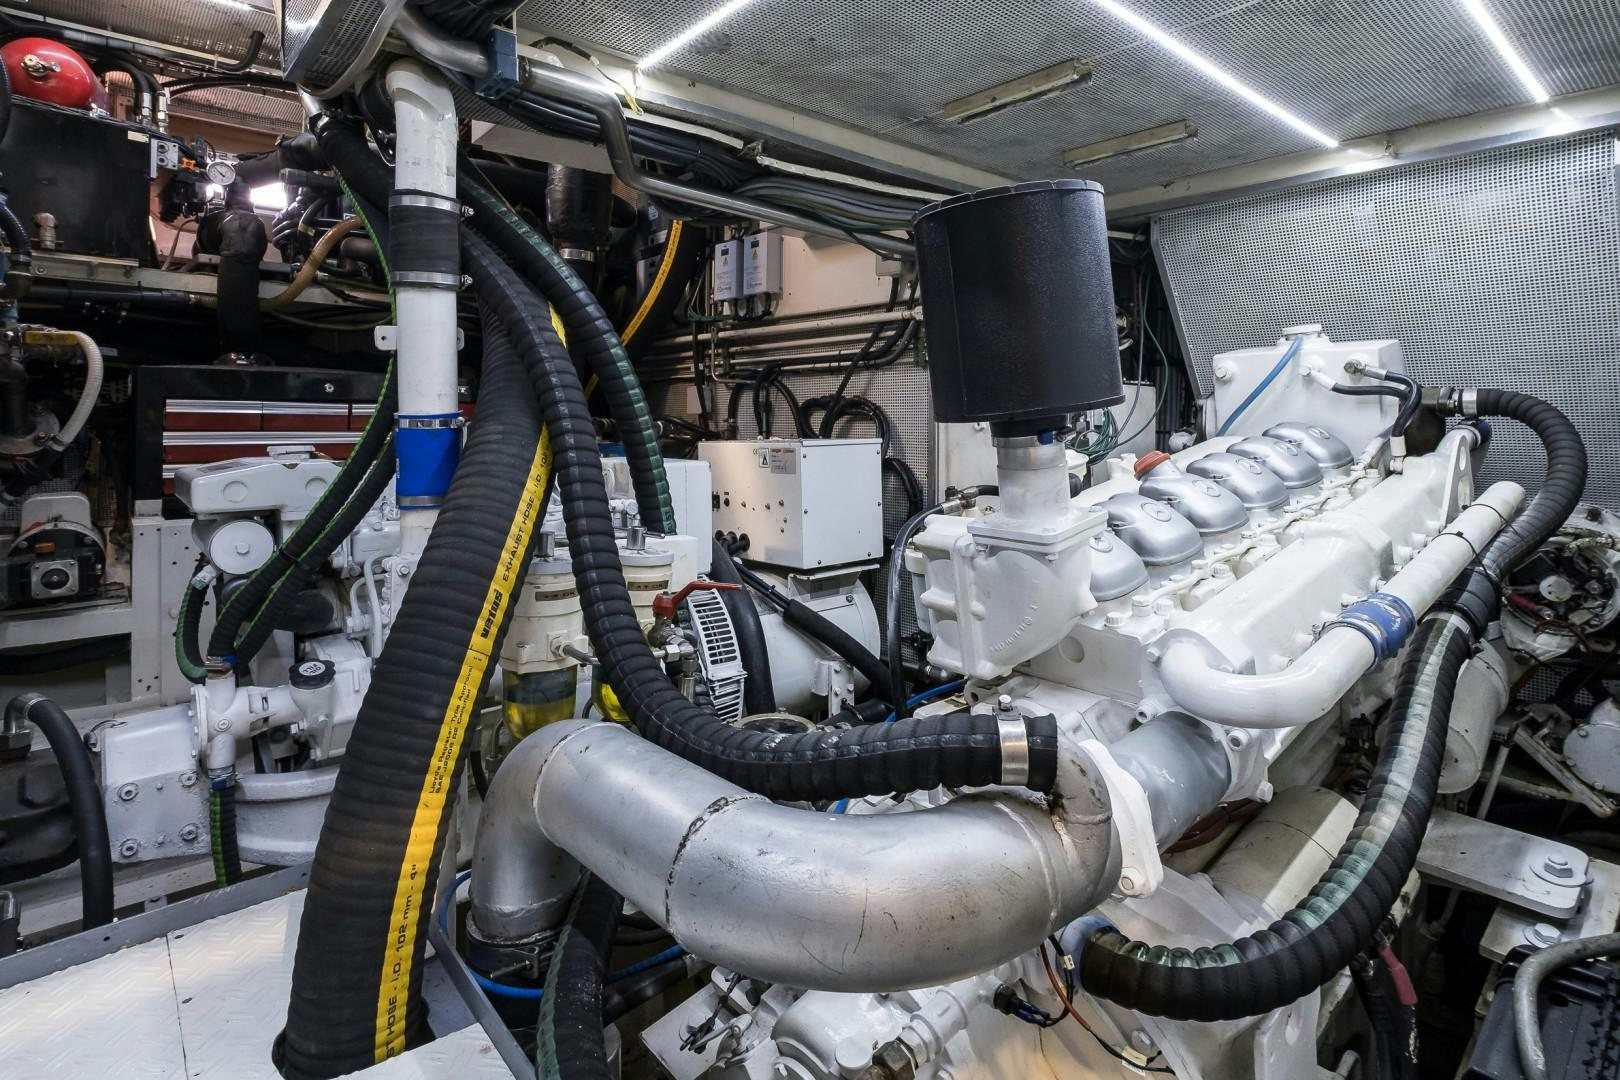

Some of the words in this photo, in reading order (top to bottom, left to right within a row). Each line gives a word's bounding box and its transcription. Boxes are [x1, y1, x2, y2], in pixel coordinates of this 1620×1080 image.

[481, 588, 503, 639] vetus
[503, 526, 524, 582] EXHAUST
[522, 496, 534, 525] HOSE
[438, 726, 452, 763] Register
[451, 704, 461, 723] Type
[458, 665, 473, 701] Approval
[435, 774, 444, 794] SAE
[387, 995, 397, 1037] HOSE
[396, 923, 408, 952] 102
[403, 895, 412, 920] mm
